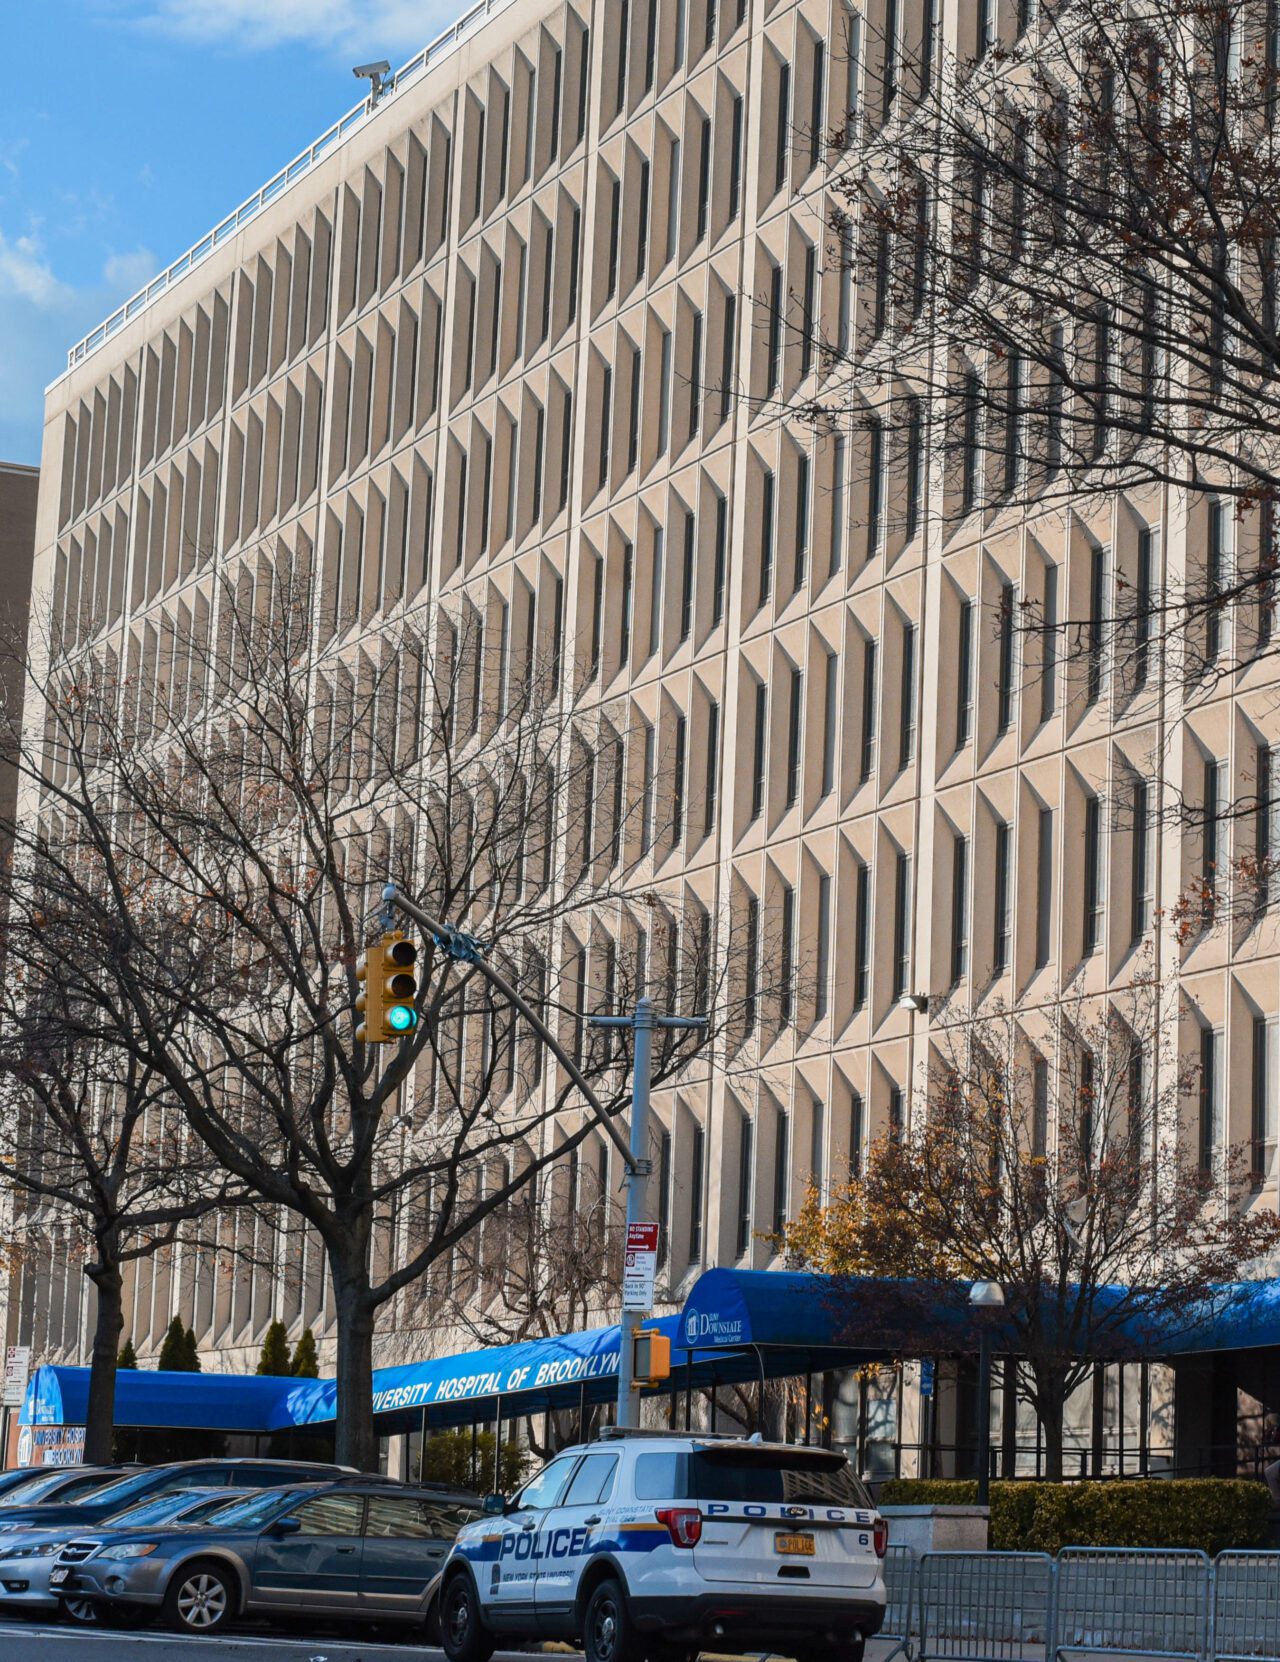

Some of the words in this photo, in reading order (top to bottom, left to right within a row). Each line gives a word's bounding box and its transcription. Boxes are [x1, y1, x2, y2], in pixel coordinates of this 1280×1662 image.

[372, 1382, 433, 1411] IVERSITY
[434, 1371, 502, 1400] HOSPITAL
[506, 1366, 529, 1390] OF
[534, 1352, 621, 1387] BROOKLYN
[707, 1503, 870, 1524] POLICE
[499, 1527, 589, 1561] POLICE
[788, 1538, 815, 1551] POLICE
[858, 1533, 869, 1546] 6
